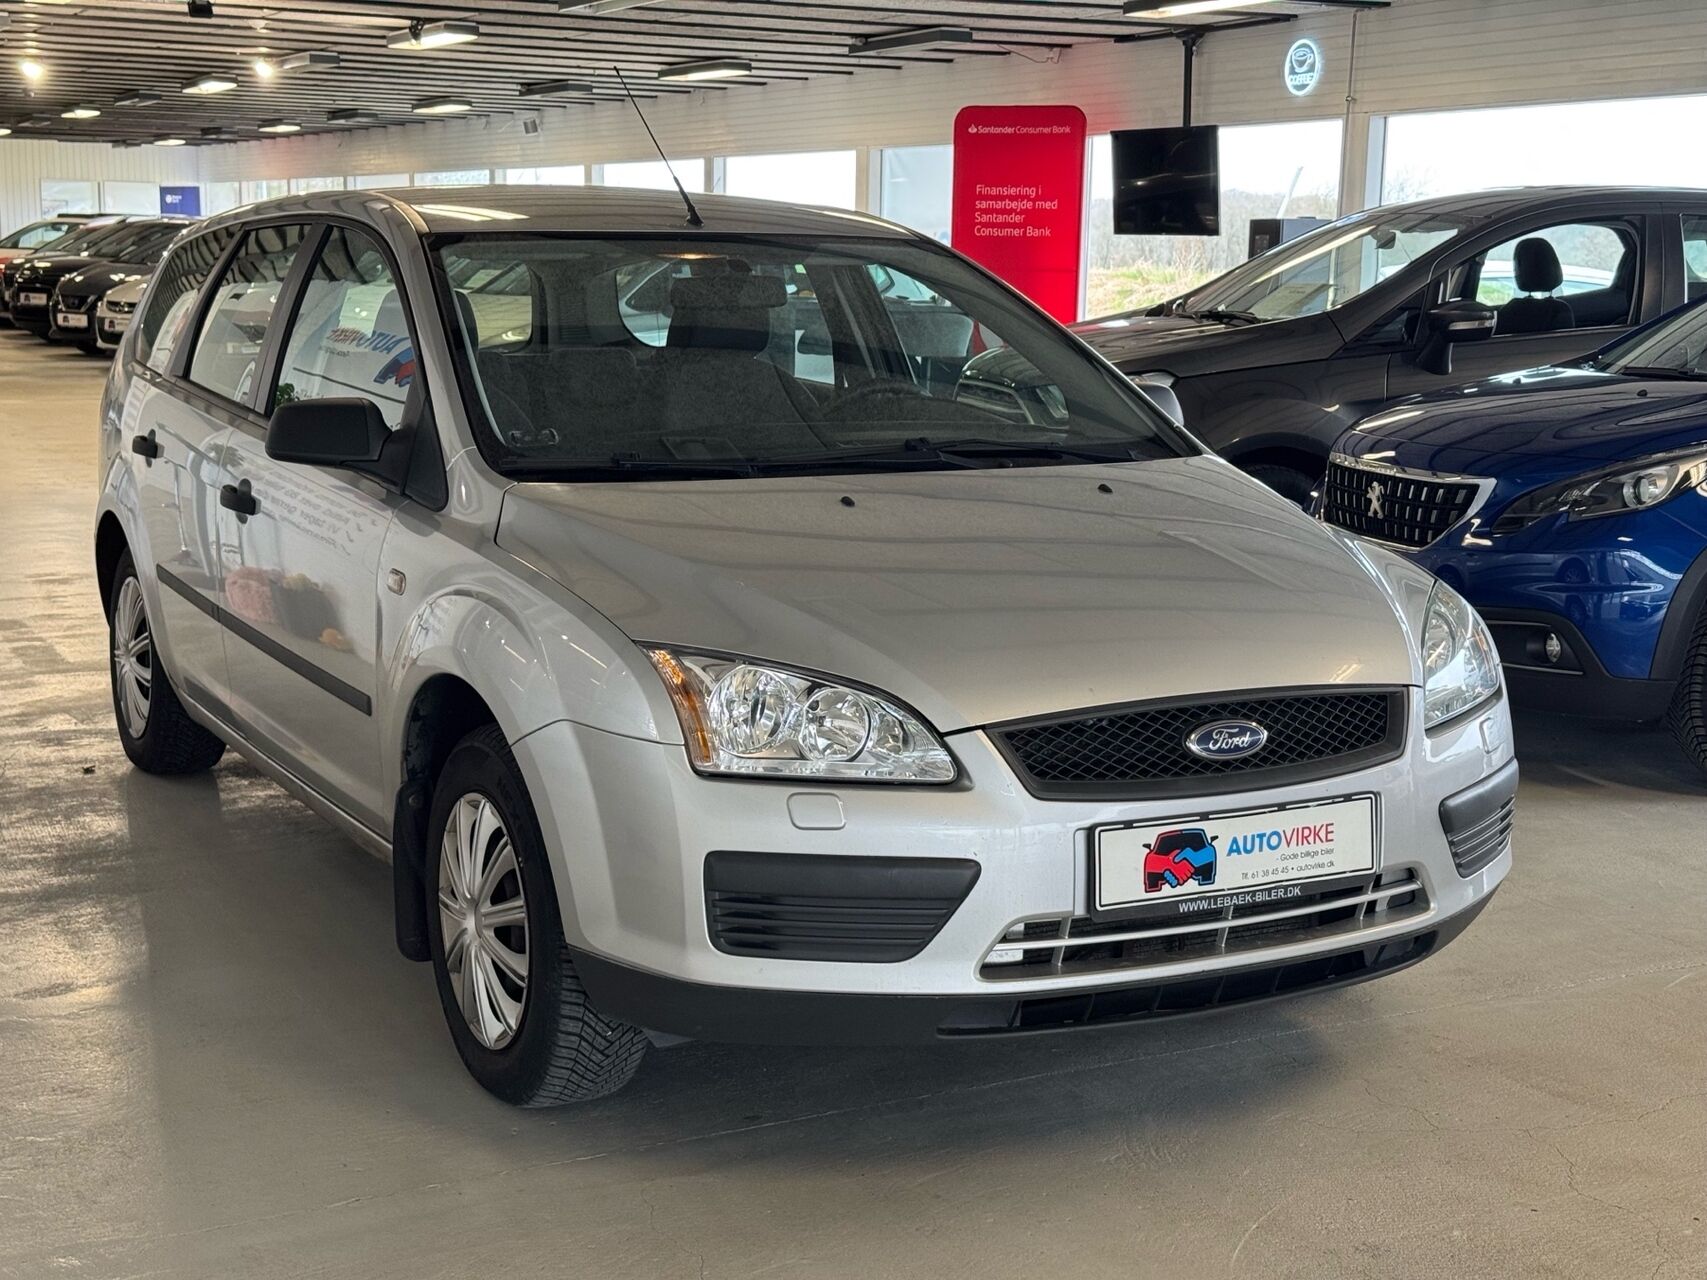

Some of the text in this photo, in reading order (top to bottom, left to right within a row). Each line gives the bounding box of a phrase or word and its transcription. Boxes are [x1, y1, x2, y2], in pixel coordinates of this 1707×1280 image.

[978, 125, 1071, 134] Santander Consumer Bank
[976, 184, 1036, 198] Finansiering
[975, 199, 1058, 211] samarbejde med
[974, 211, 1025, 223] Santander
[974, 225, 1051, 237] Consumer Bank
[1209, 728, 1250, 750] Ford
[1226, 823, 1335, 857] AUTOVIRKE
[1280, 853, 1299, 861] Gode
[1300, 850, 1319, 859] billige
[1320, 847, 1335, 856] biler
[1251, 870, 1259, 880] 61
[1261, 868, 1270, 878] 38
[1271, 867, 1280, 876] 45
[1281, 865, 1290, 874] 45
[1296, 860, 1335, 872] autovirkedk
[1179, 886, 1301, 913] WWW.LEBAEK-BILER.DK
